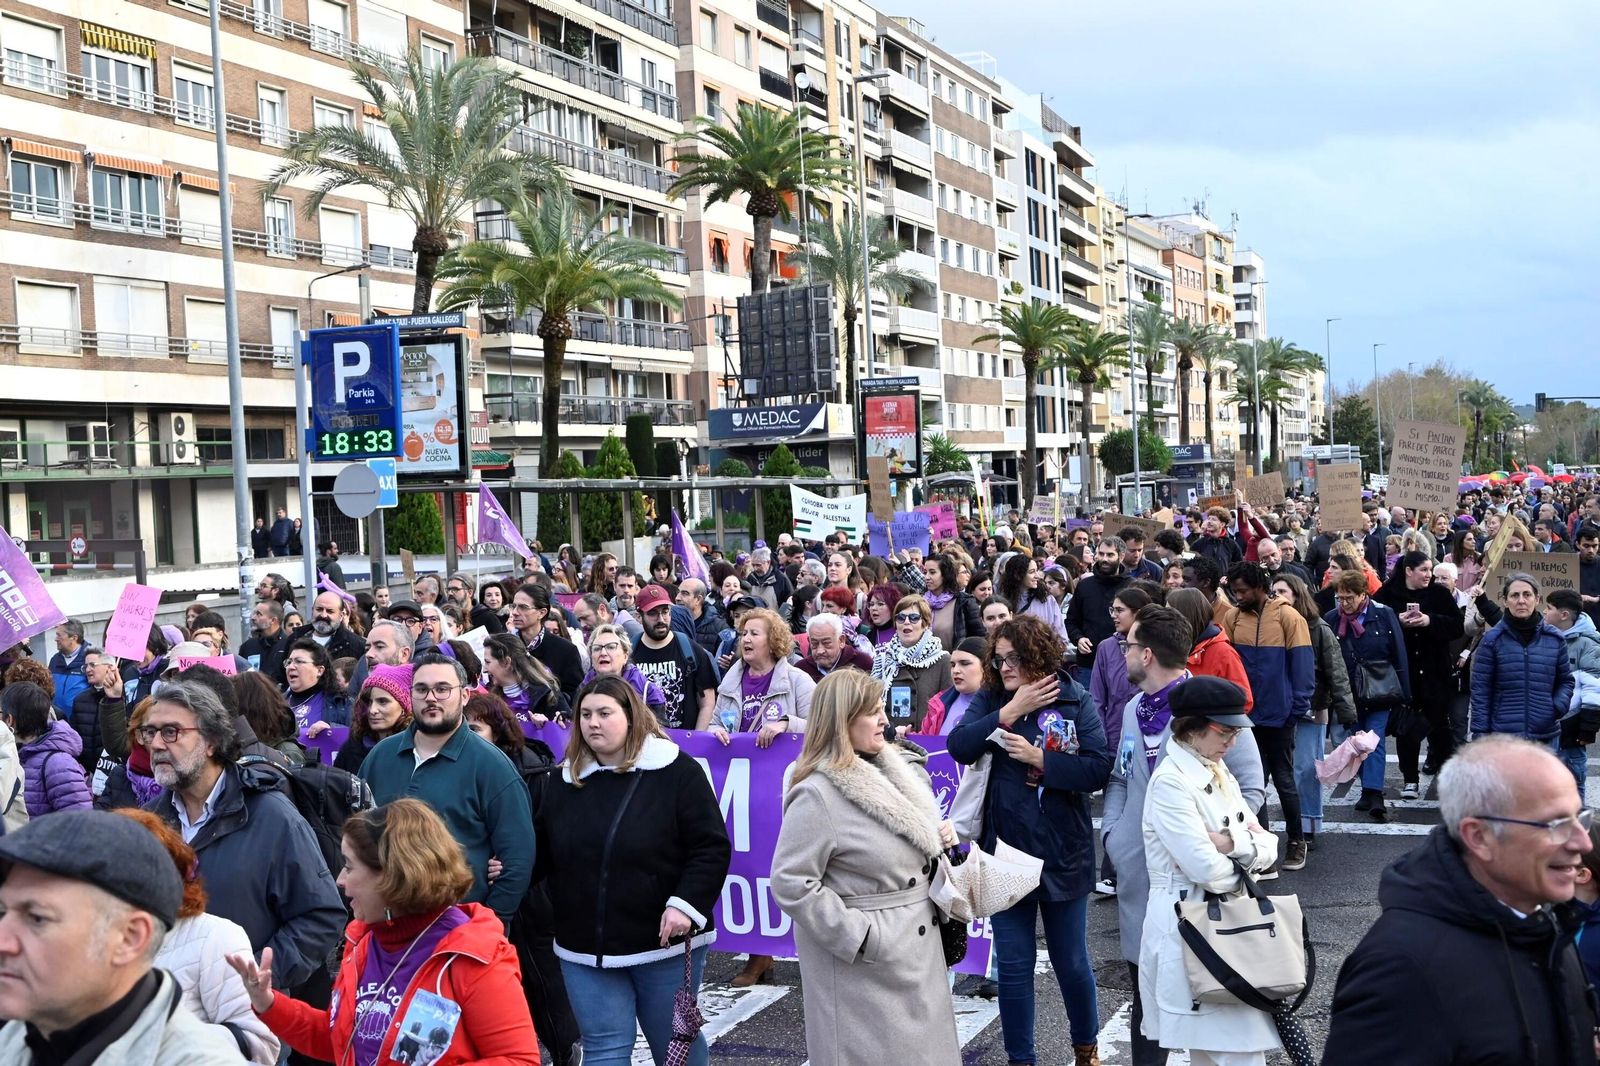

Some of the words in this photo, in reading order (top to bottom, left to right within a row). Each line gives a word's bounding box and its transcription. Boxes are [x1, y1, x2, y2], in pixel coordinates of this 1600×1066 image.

[411, 317, 432, 325] PUERTA
[432, 315, 460, 324] GALLEGOS
[333, 341, 371, 403] P
[349, 389, 375, 399] Parkia
[744, 410, 801, 426] MEDAC
[322, 430, 393, 455] 18:33
[1399, 439, 1428, 454] PAREDES
[1432, 445, 1457, 457] PARECE
[1397, 466, 1418, 476] MATAN
[1421, 469, 1450, 481] MUJERES
[379, 475, 395, 490] AXI
[1415, 481, 1420, 489] A
[1400, 490, 1408, 498] LO
[801, 507, 820, 517] MUJER
[823, 514, 851, 522] PALESTINA
[1503, 559, 1522, 570] HOY
[1530, 561, 1568, 574] HAREMOS
[0, 602, 22, 632] alucía
[693, 757, 750, 853] M
[721, 874, 795, 937] OD
